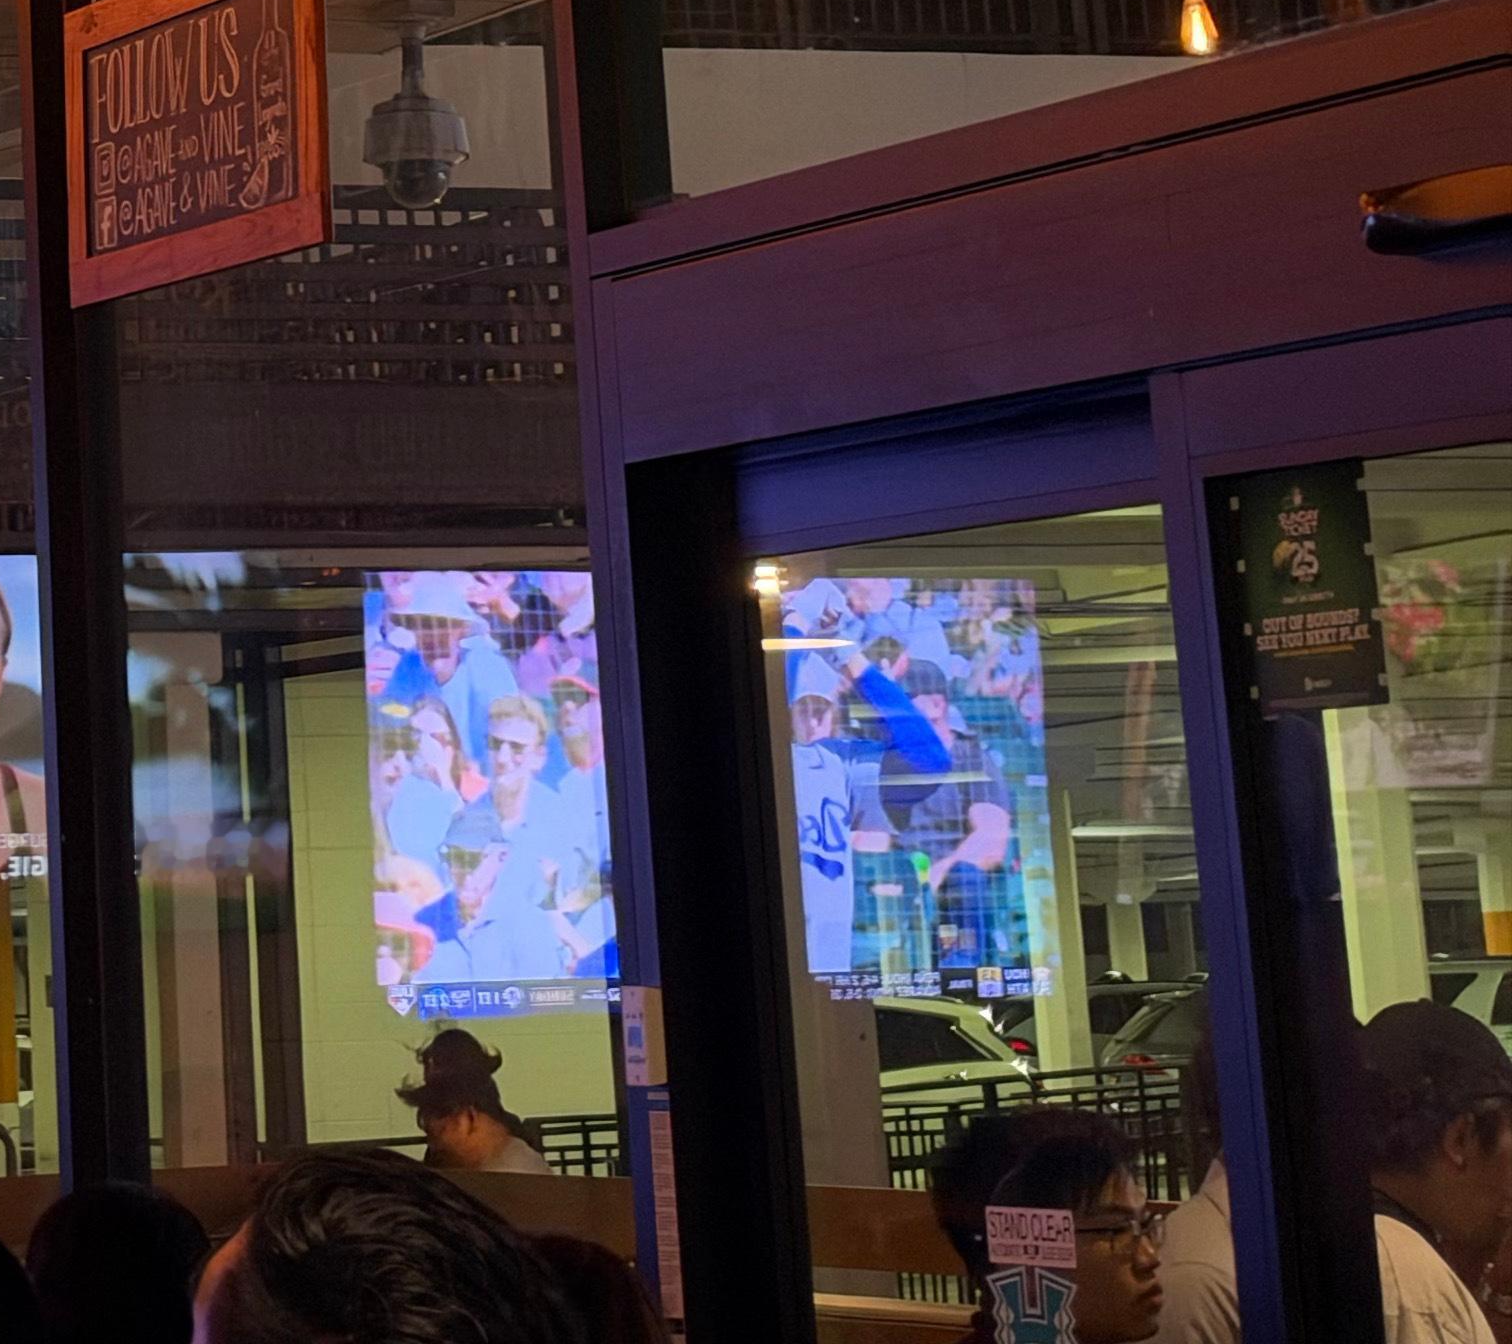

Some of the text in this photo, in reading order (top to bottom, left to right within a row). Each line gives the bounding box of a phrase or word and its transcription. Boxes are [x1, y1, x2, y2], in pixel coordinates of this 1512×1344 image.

[89, 19, 194, 145] FOLLOW
[197, 7, 240, 106] US
[199, 102, 246, 164] VINE
[196, 164, 237, 214] VINE
[989, 1211, 1072, 1242] STAND CLEAR
